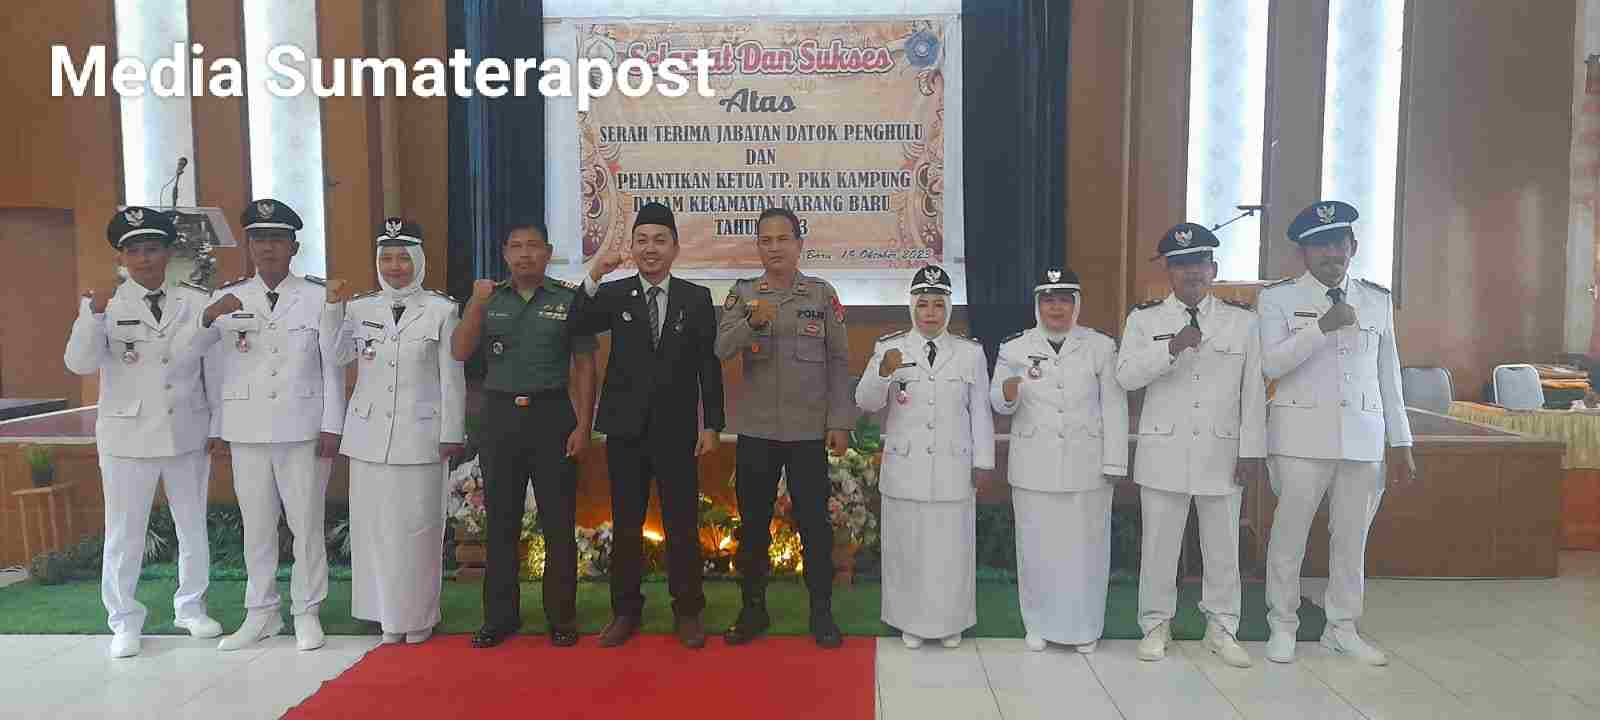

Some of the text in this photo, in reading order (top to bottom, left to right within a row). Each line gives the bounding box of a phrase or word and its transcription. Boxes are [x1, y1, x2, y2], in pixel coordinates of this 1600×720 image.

[735, 40, 795, 75] Dan
[797, 39, 896, 74] Sukses
[719, 87, 796, 113] Atas
[600, 123, 923, 143] SERAH TERIMA JABATAN DATOK PENGHULU
[746, 148, 776, 165] DAN
[617, 171, 911, 189] PELANTIKAN KETUA TP. PKK KAMPUNG
[689, 195, 776, 212] KECAMATAN
[782, 195, 843, 212] KARANG
[850, 195, 890, 212] BARU
